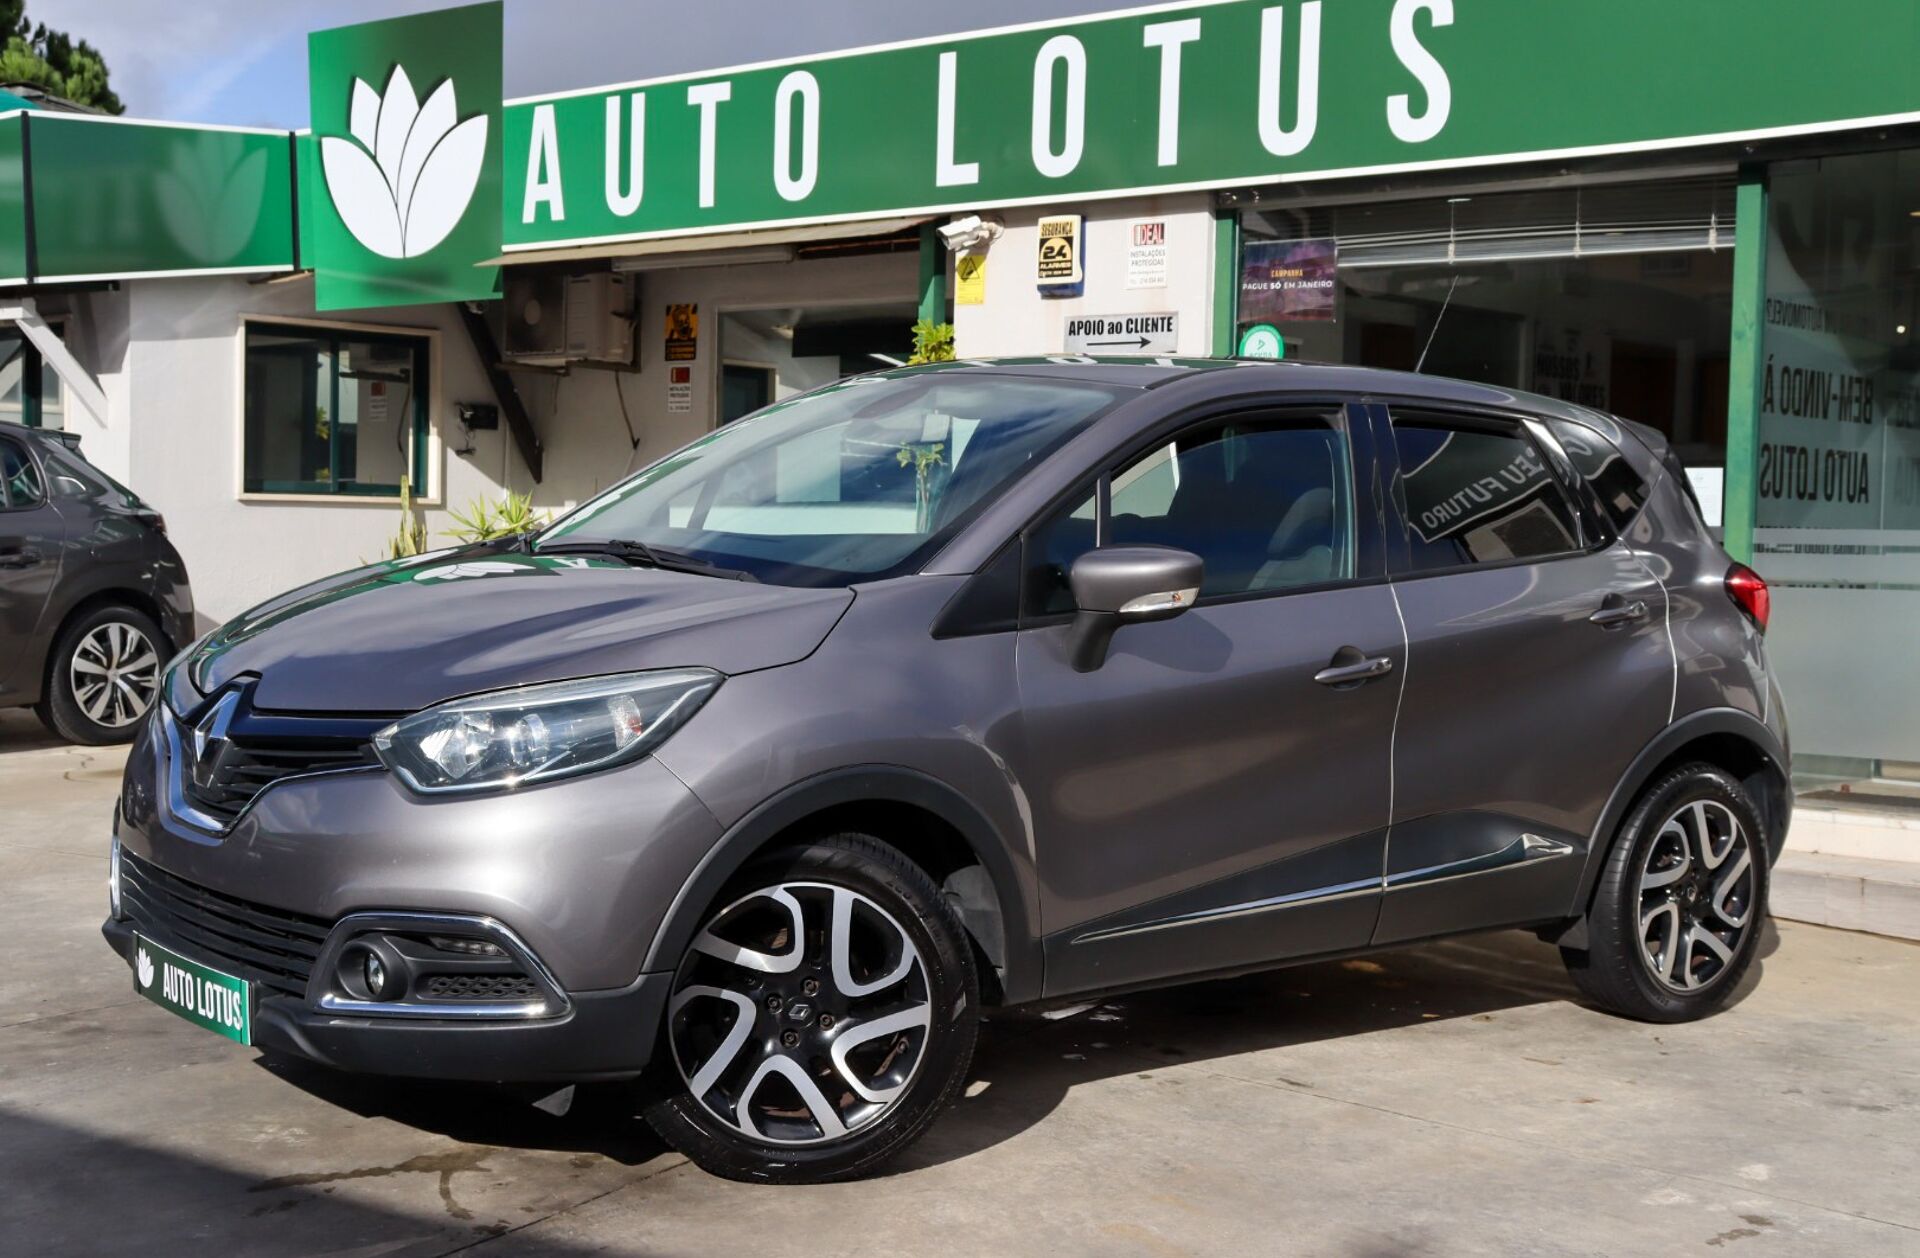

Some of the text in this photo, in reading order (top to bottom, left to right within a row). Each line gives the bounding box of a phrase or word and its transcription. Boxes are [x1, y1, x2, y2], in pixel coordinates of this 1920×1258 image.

[522, 0, 1454, 224] AUTO LOTUS
[1133, 223, 1164, 246] IDEAL
[1043, 245, 1067, 259] 24
[1242, 282, 1268, 290] PAGUE
[1270, 281, 1281, 289] SÓ
[1297, 280, 1333, 289] JANEIRO
[1068, 316, 1173, 336] APOIO ao CLIENTE
[163, 962, 243, 1031] AUTO LOTUS
